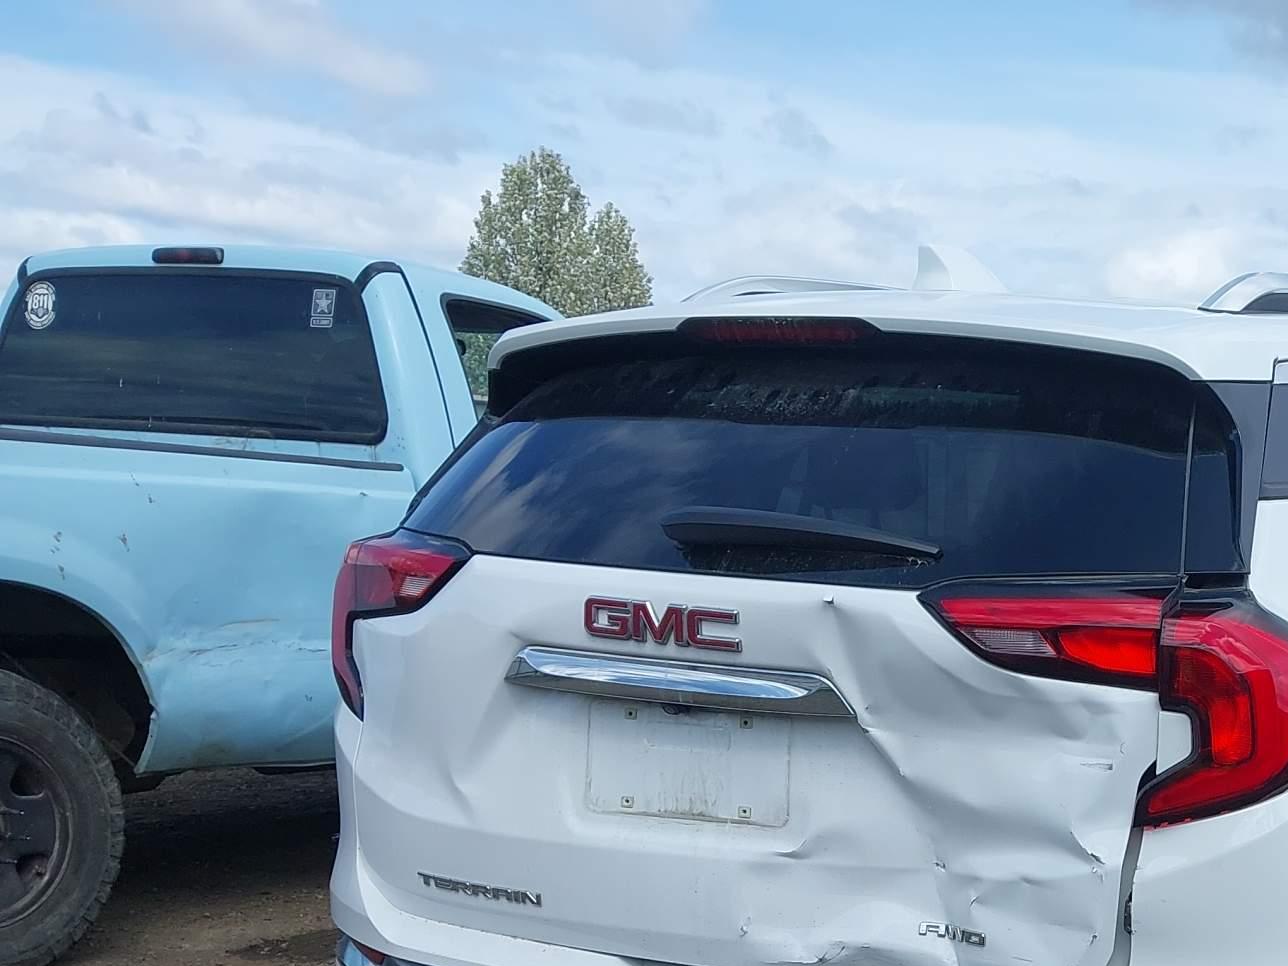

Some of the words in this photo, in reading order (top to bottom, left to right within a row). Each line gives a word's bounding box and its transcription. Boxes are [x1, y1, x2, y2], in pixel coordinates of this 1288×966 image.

[32, 294, 49, 309] 811
[584, 595, 743, 652] GMC
[416, 871, 542, 908] TERRAIN
[918, 921, 986, 947] AWD
